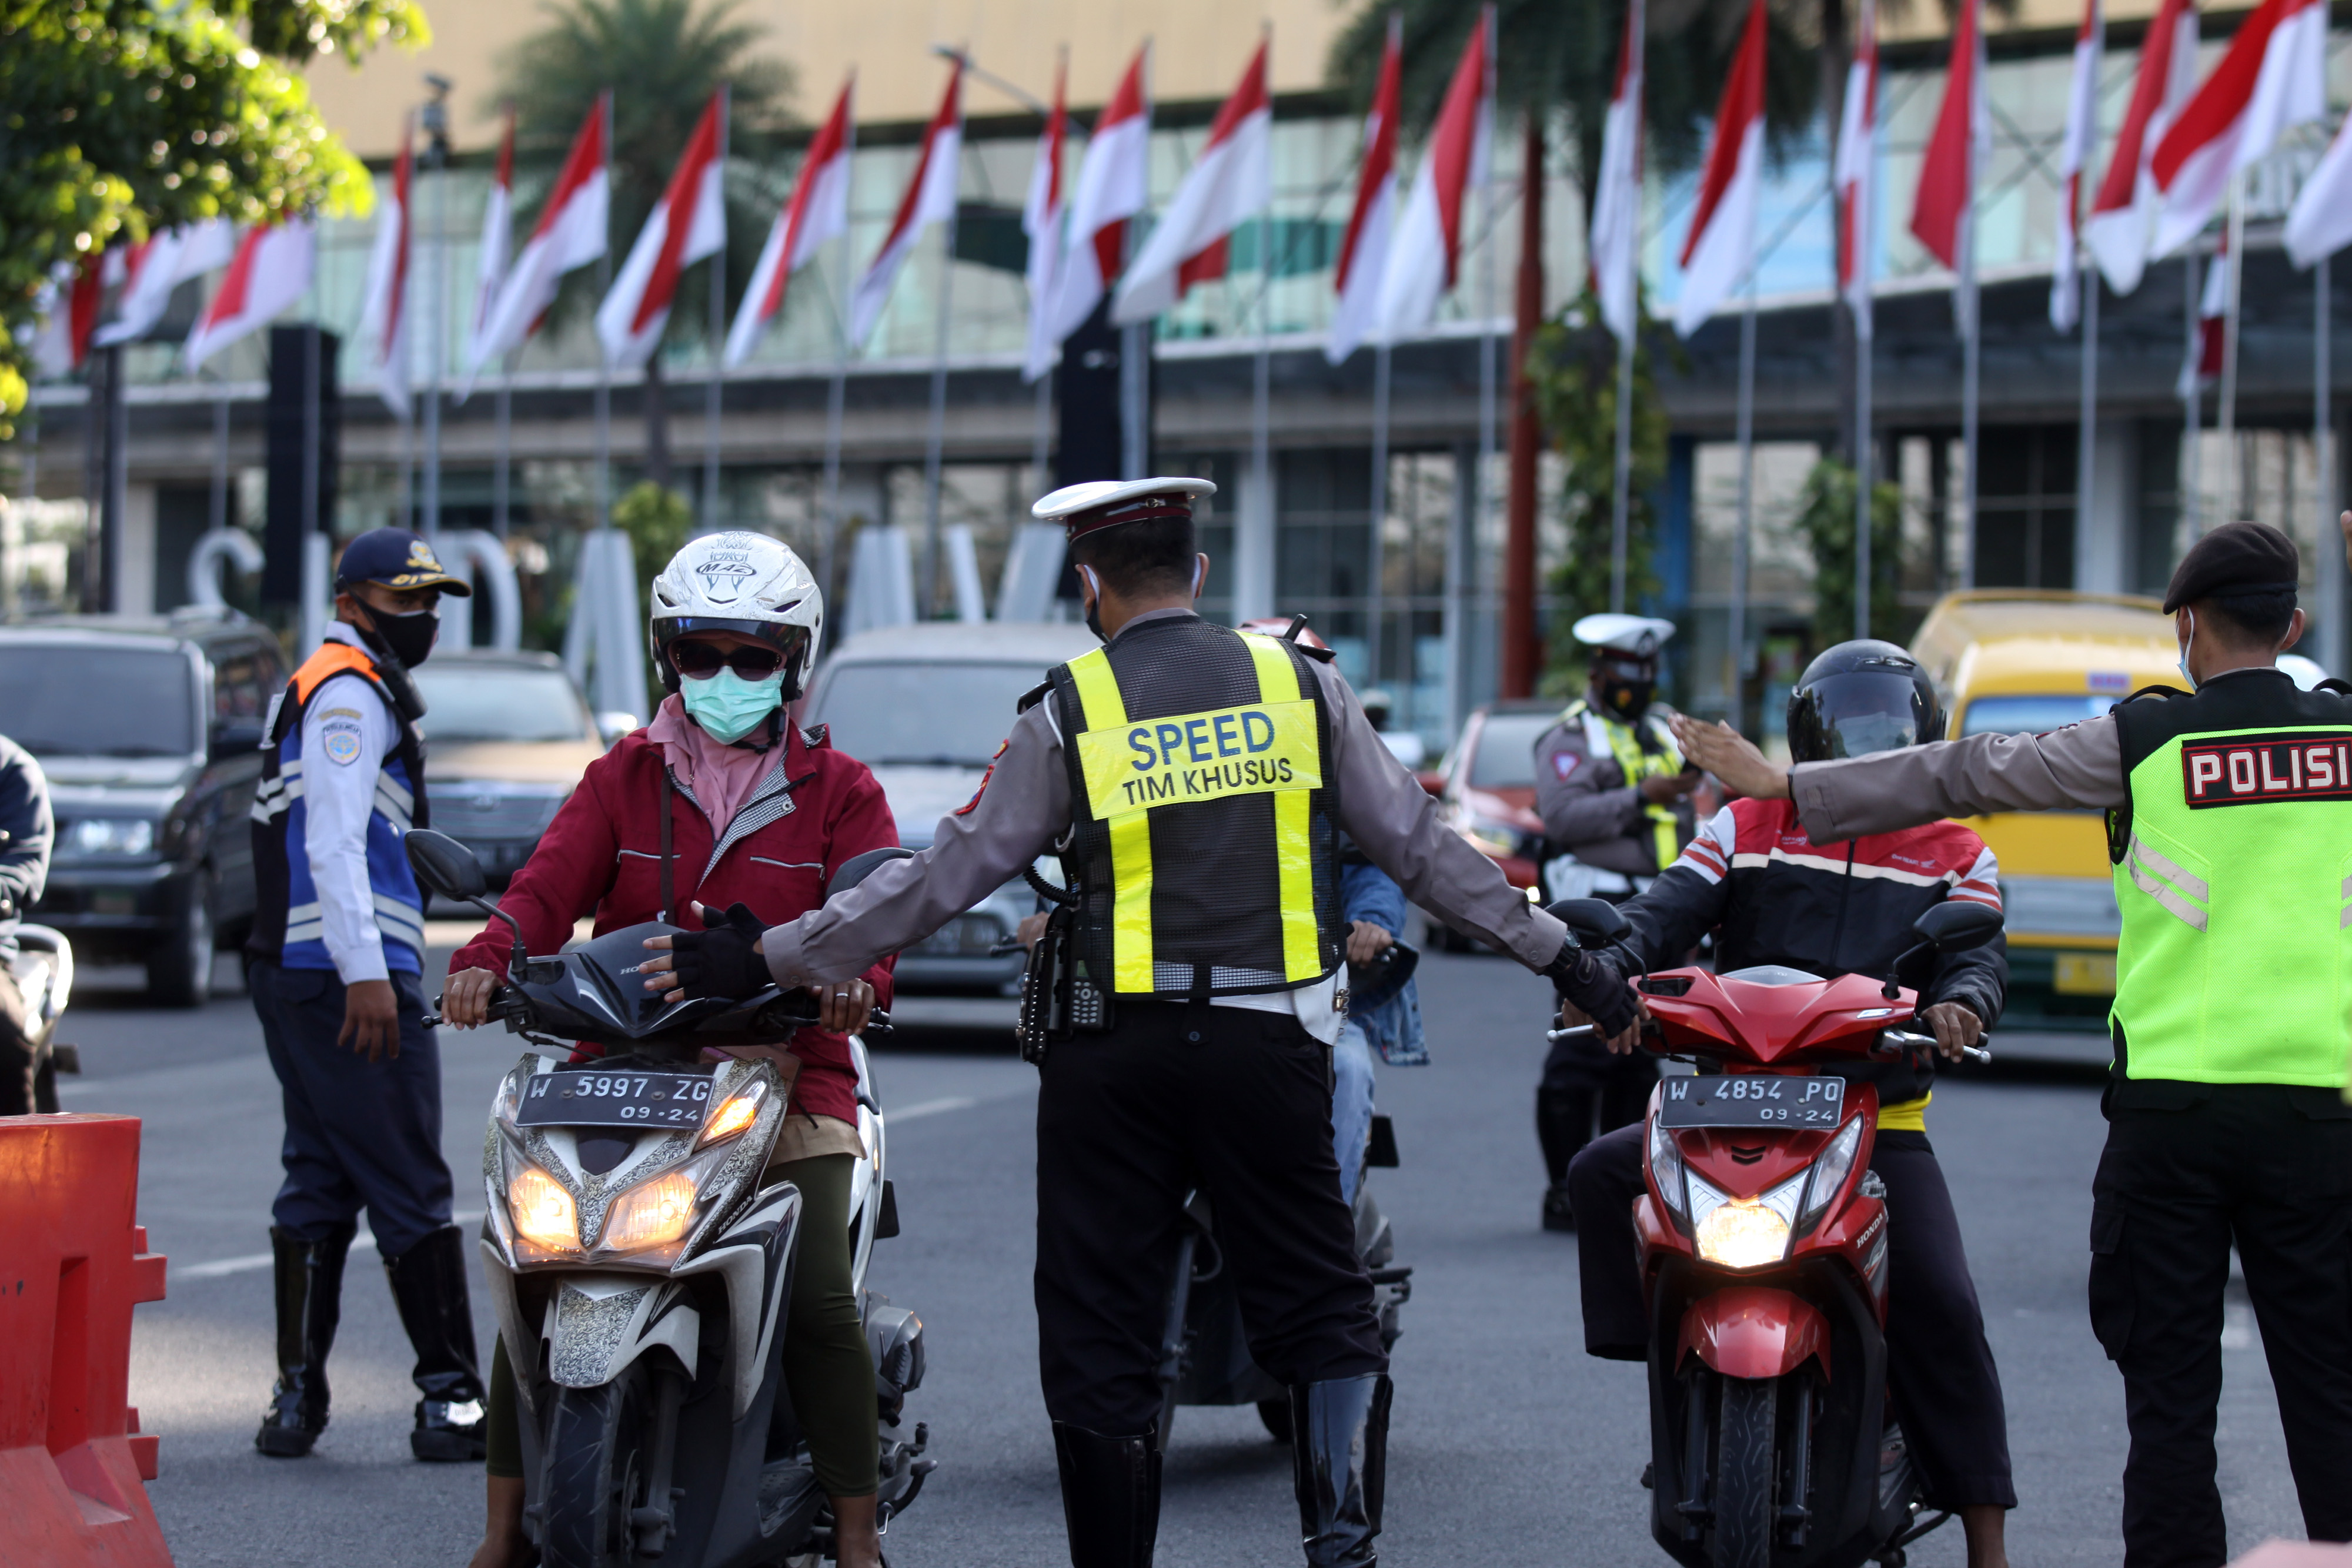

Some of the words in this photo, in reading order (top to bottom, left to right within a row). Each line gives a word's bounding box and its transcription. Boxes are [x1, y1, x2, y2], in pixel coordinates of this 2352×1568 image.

[1128, 711, 1275, 771] SPEED
[1122, 773, 1175, 805] TIM
[1183, 758, 1292, 794] KHUSUS
[2190, 744, 2349, 797] POLISI
[530, 1078, 552, 1098] W
[576, 1076, 649, 1098] 5997
[673, 1080, 709, 1101] ZG
[1671, 1081, 1688, 1101] W
[1715, 1081, 1782, 1099] 4854
[719, 1195, 753, 1233] HONDA
[1857, 1213, 1883, 1249] HONDA
